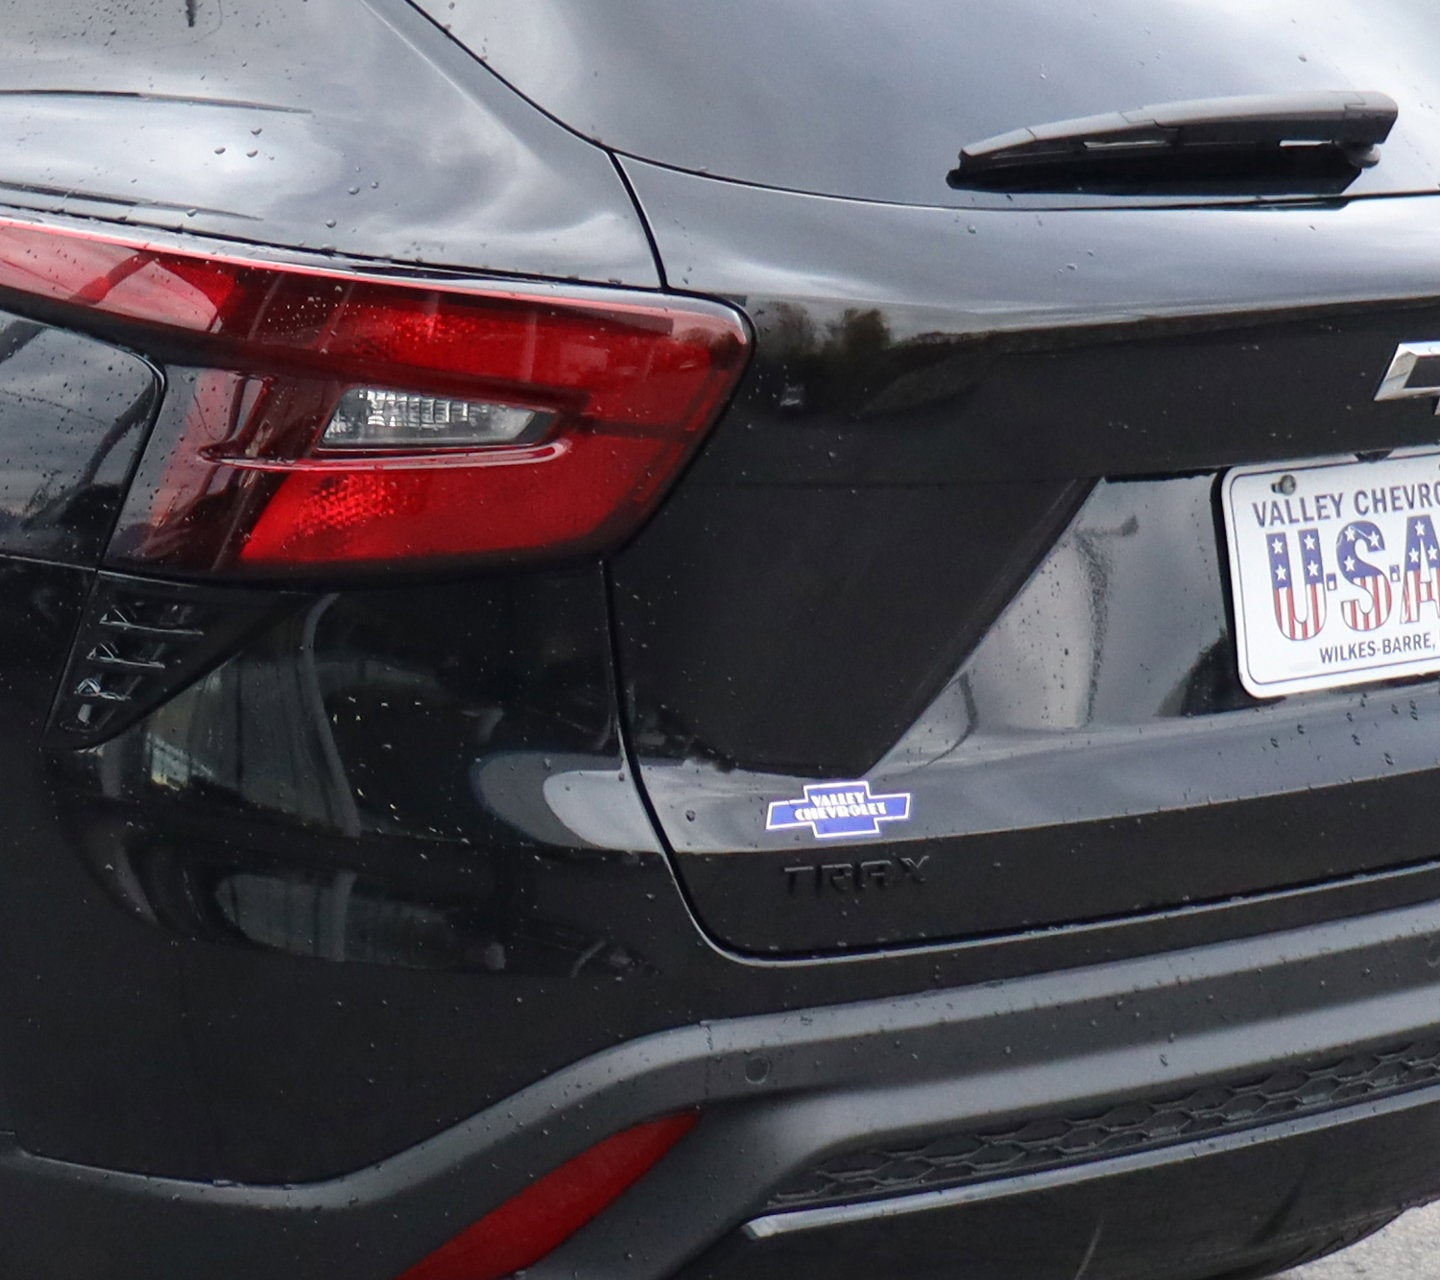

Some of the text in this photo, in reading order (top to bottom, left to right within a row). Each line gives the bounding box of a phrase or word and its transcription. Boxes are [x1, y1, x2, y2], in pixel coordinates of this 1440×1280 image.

[1252, 491, 1344, 528] VALLEY
[1319, 631, 1436, 664] WILKES-BARRE,
[794, 801, 887, 821] CHEVROLET
[810, 791, 865, 808] VALLEY
[783, 854, 930, 897] TRAX
